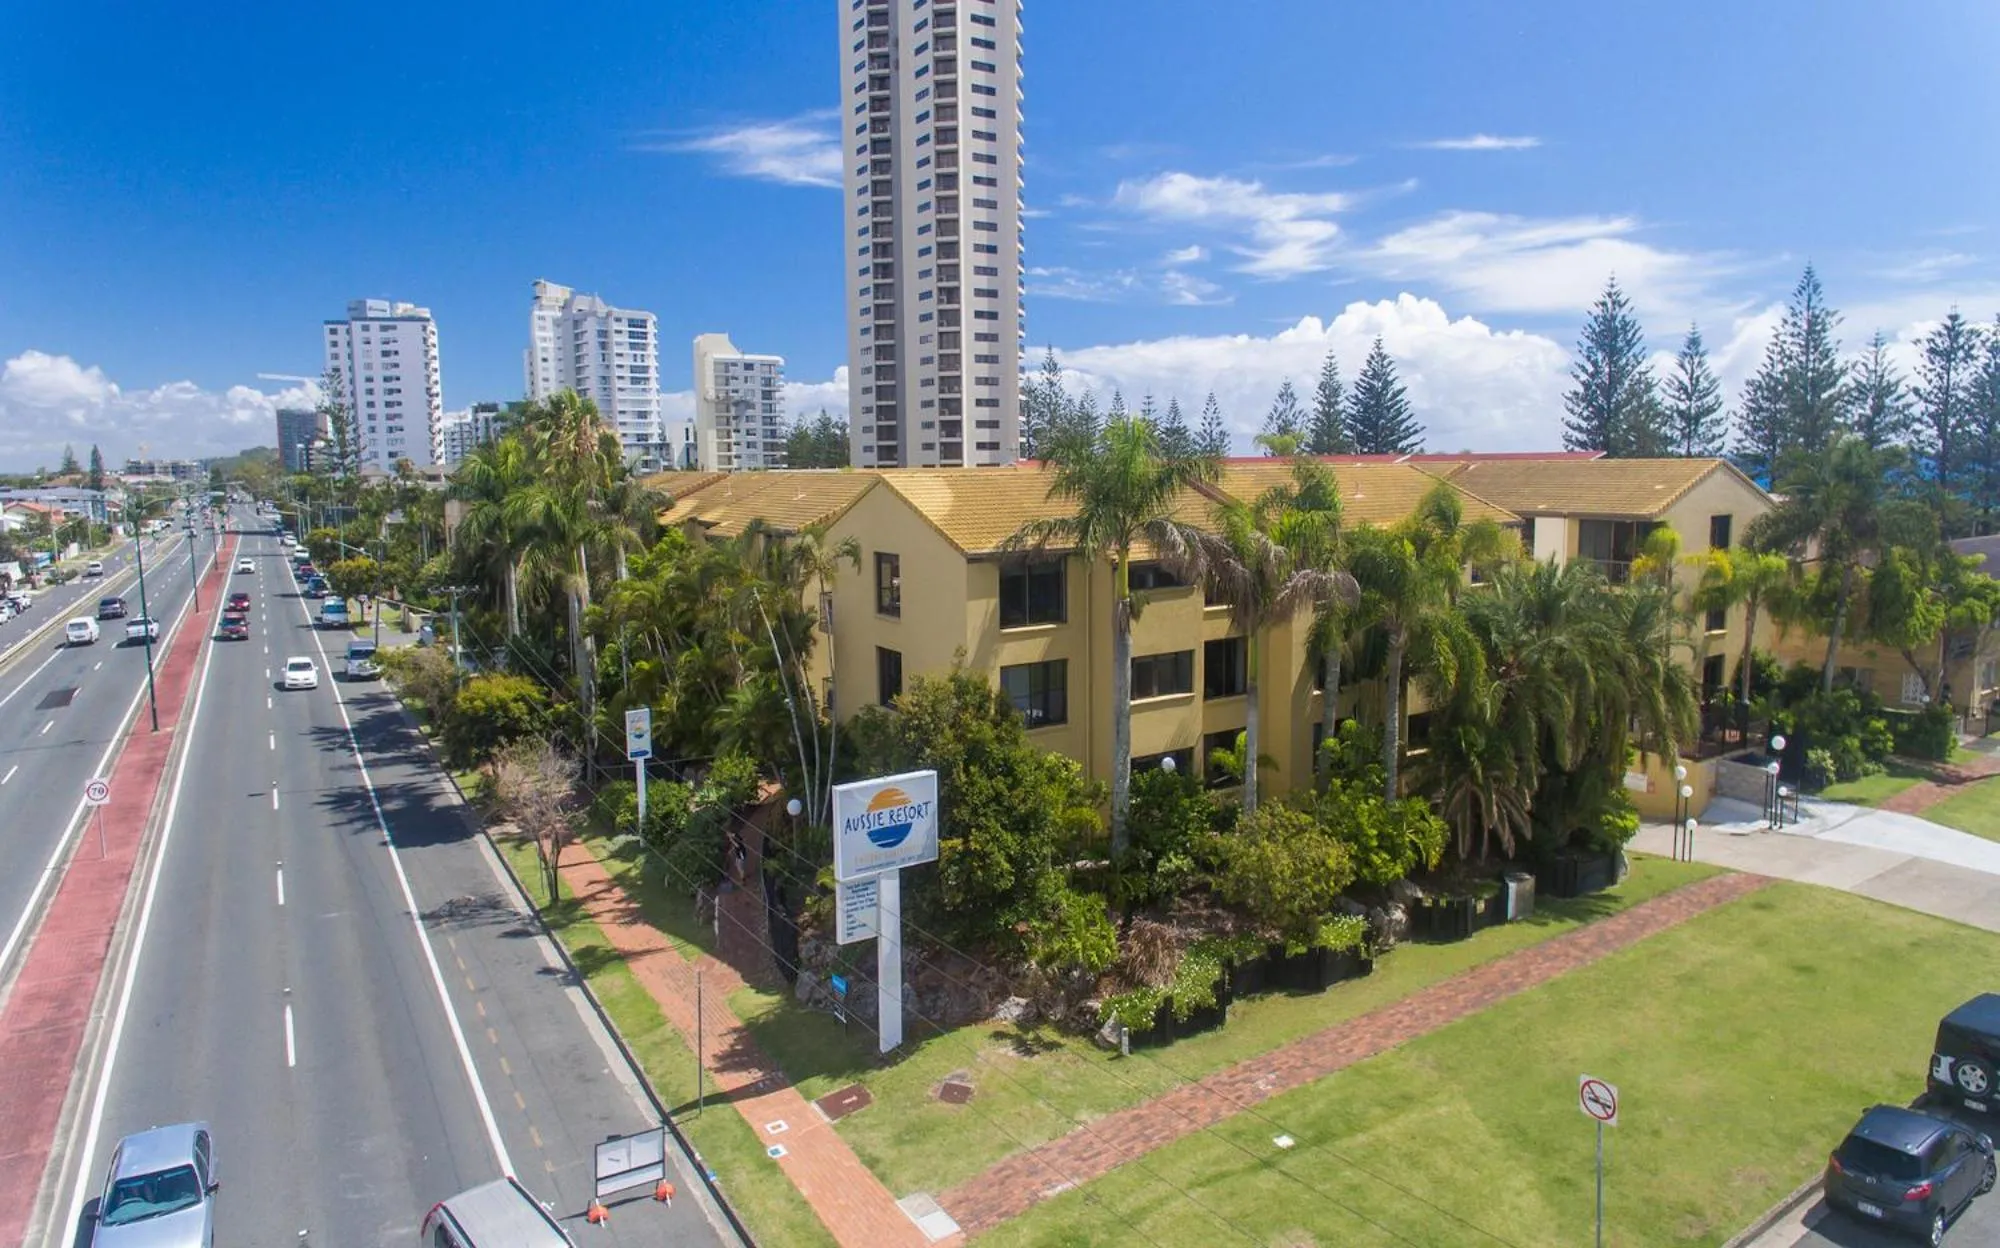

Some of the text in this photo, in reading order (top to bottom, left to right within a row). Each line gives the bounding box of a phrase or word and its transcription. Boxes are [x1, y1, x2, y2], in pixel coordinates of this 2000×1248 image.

[91, 787, 105, 796] 70
[844, 800, 931, 835] AUSSIE RESORT
